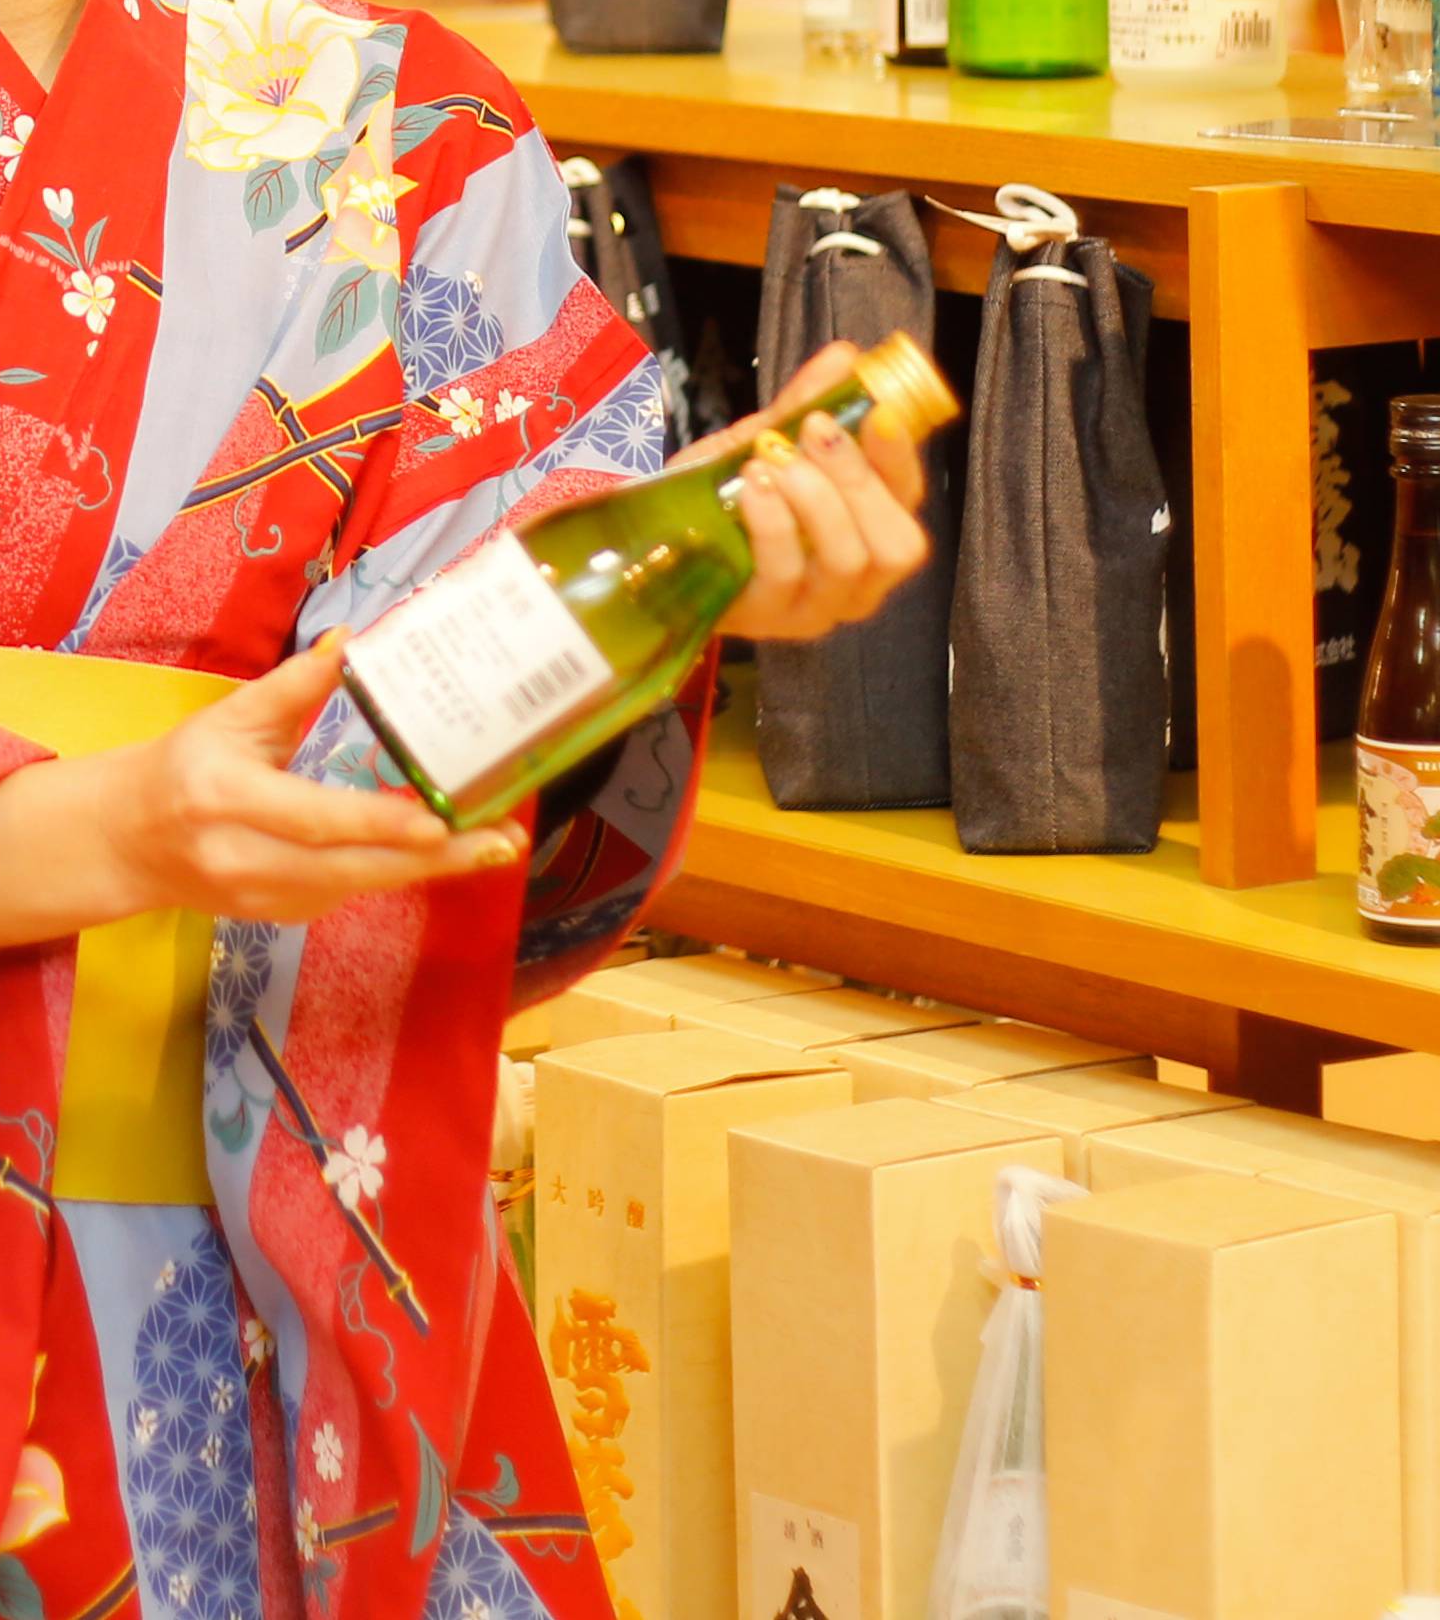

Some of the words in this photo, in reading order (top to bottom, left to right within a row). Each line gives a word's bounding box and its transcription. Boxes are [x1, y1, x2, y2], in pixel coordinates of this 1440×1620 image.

[550, 1175, 646, 1231] 大吟醸
[549, 1287, 652, 1620] 雪彦
